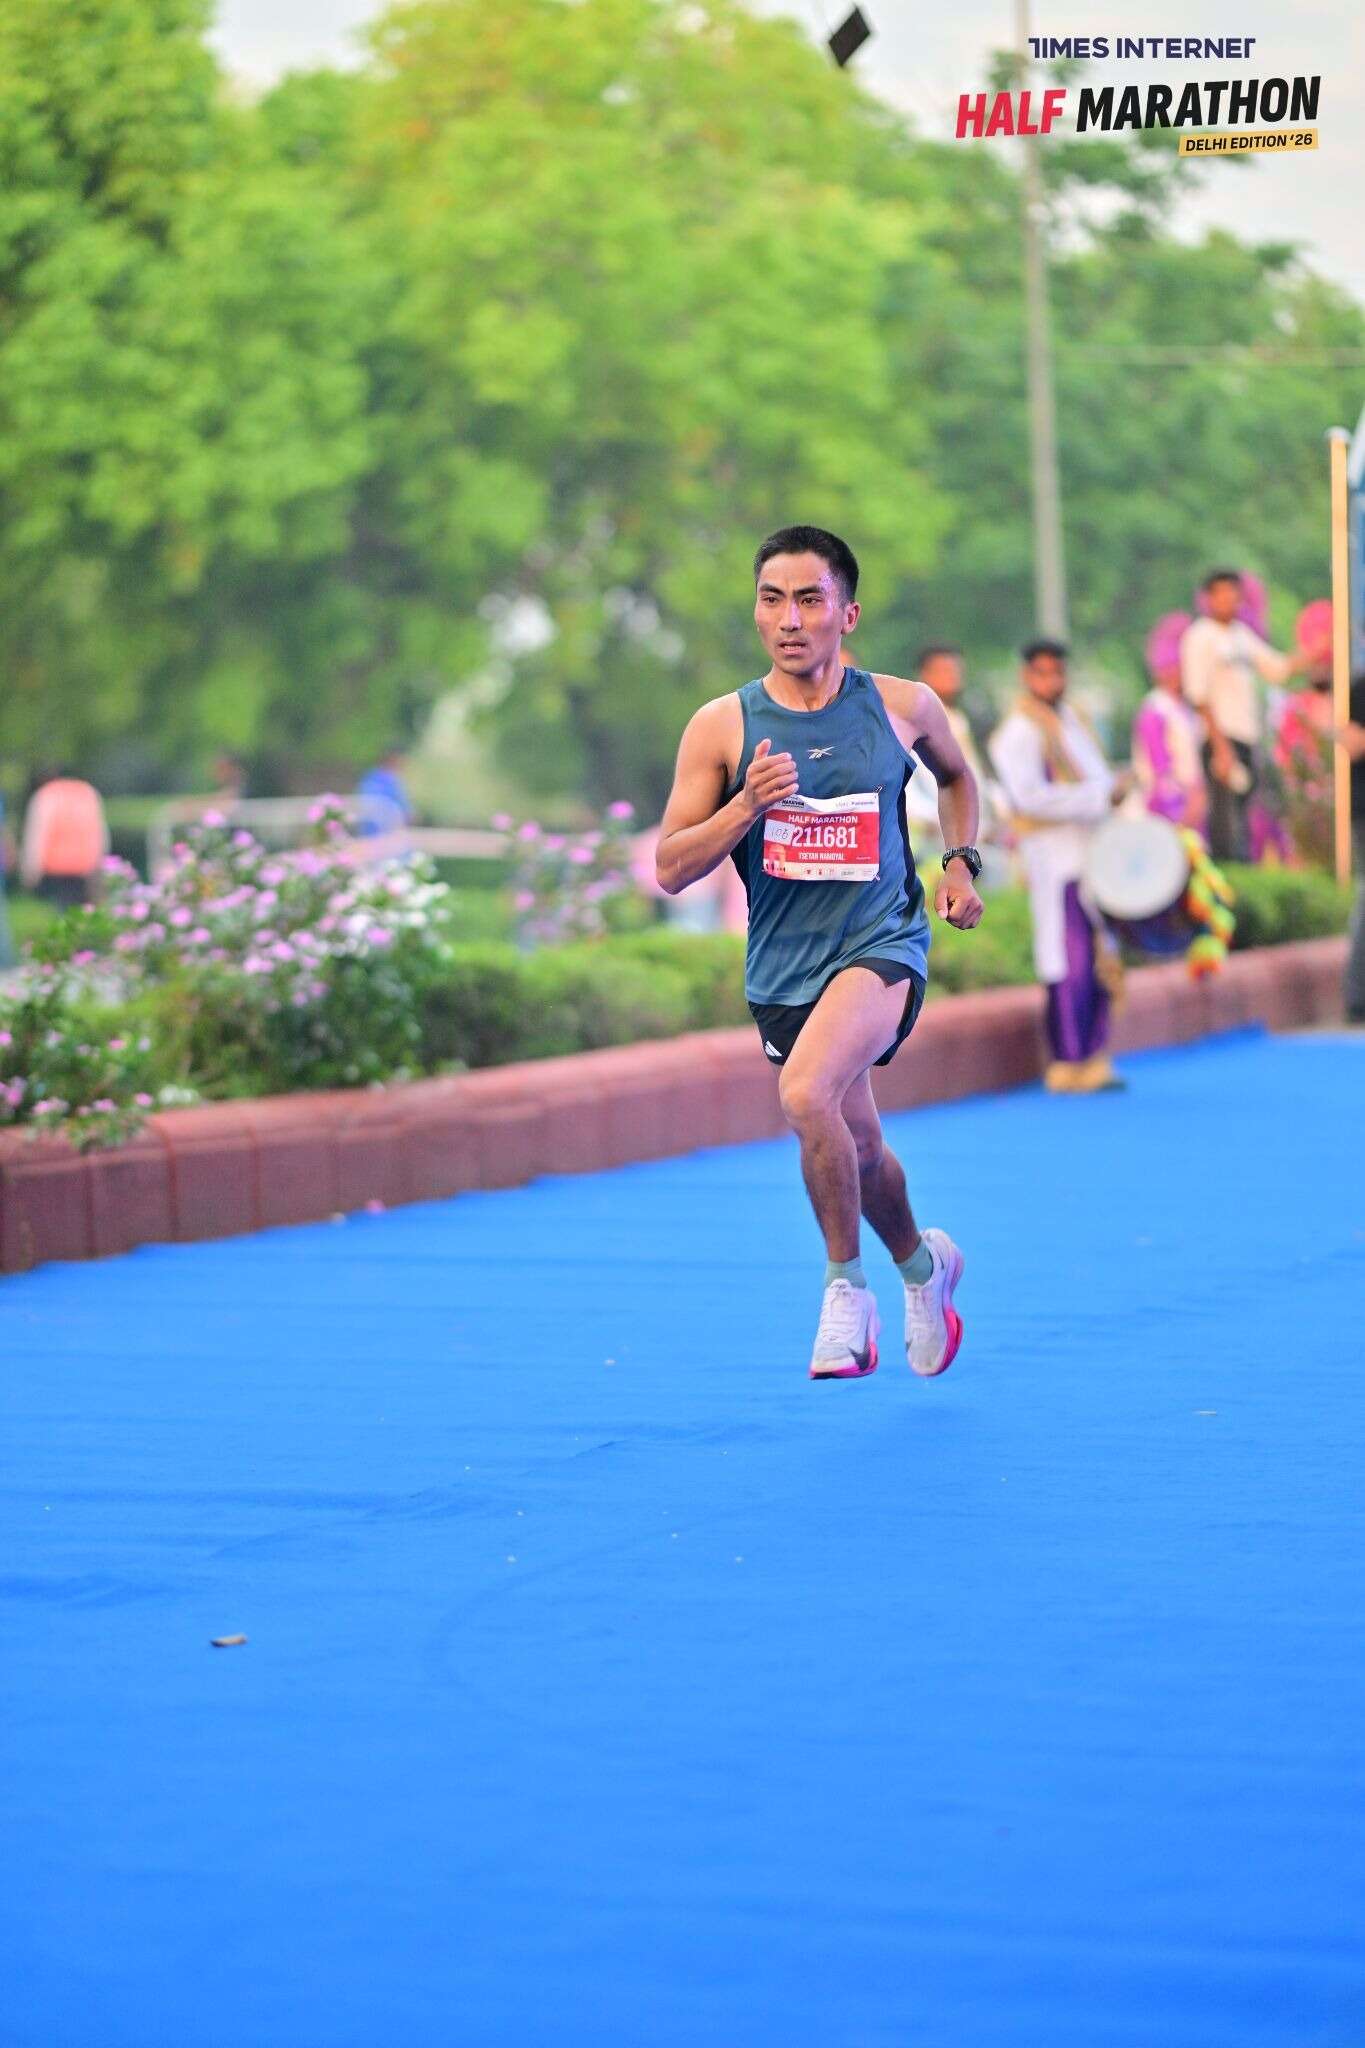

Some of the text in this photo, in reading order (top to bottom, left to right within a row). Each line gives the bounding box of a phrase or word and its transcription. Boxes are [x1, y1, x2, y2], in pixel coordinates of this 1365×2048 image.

[788, 814, 858, 824] HALF MARATHON
[791, 826, 858, 848] 211681
